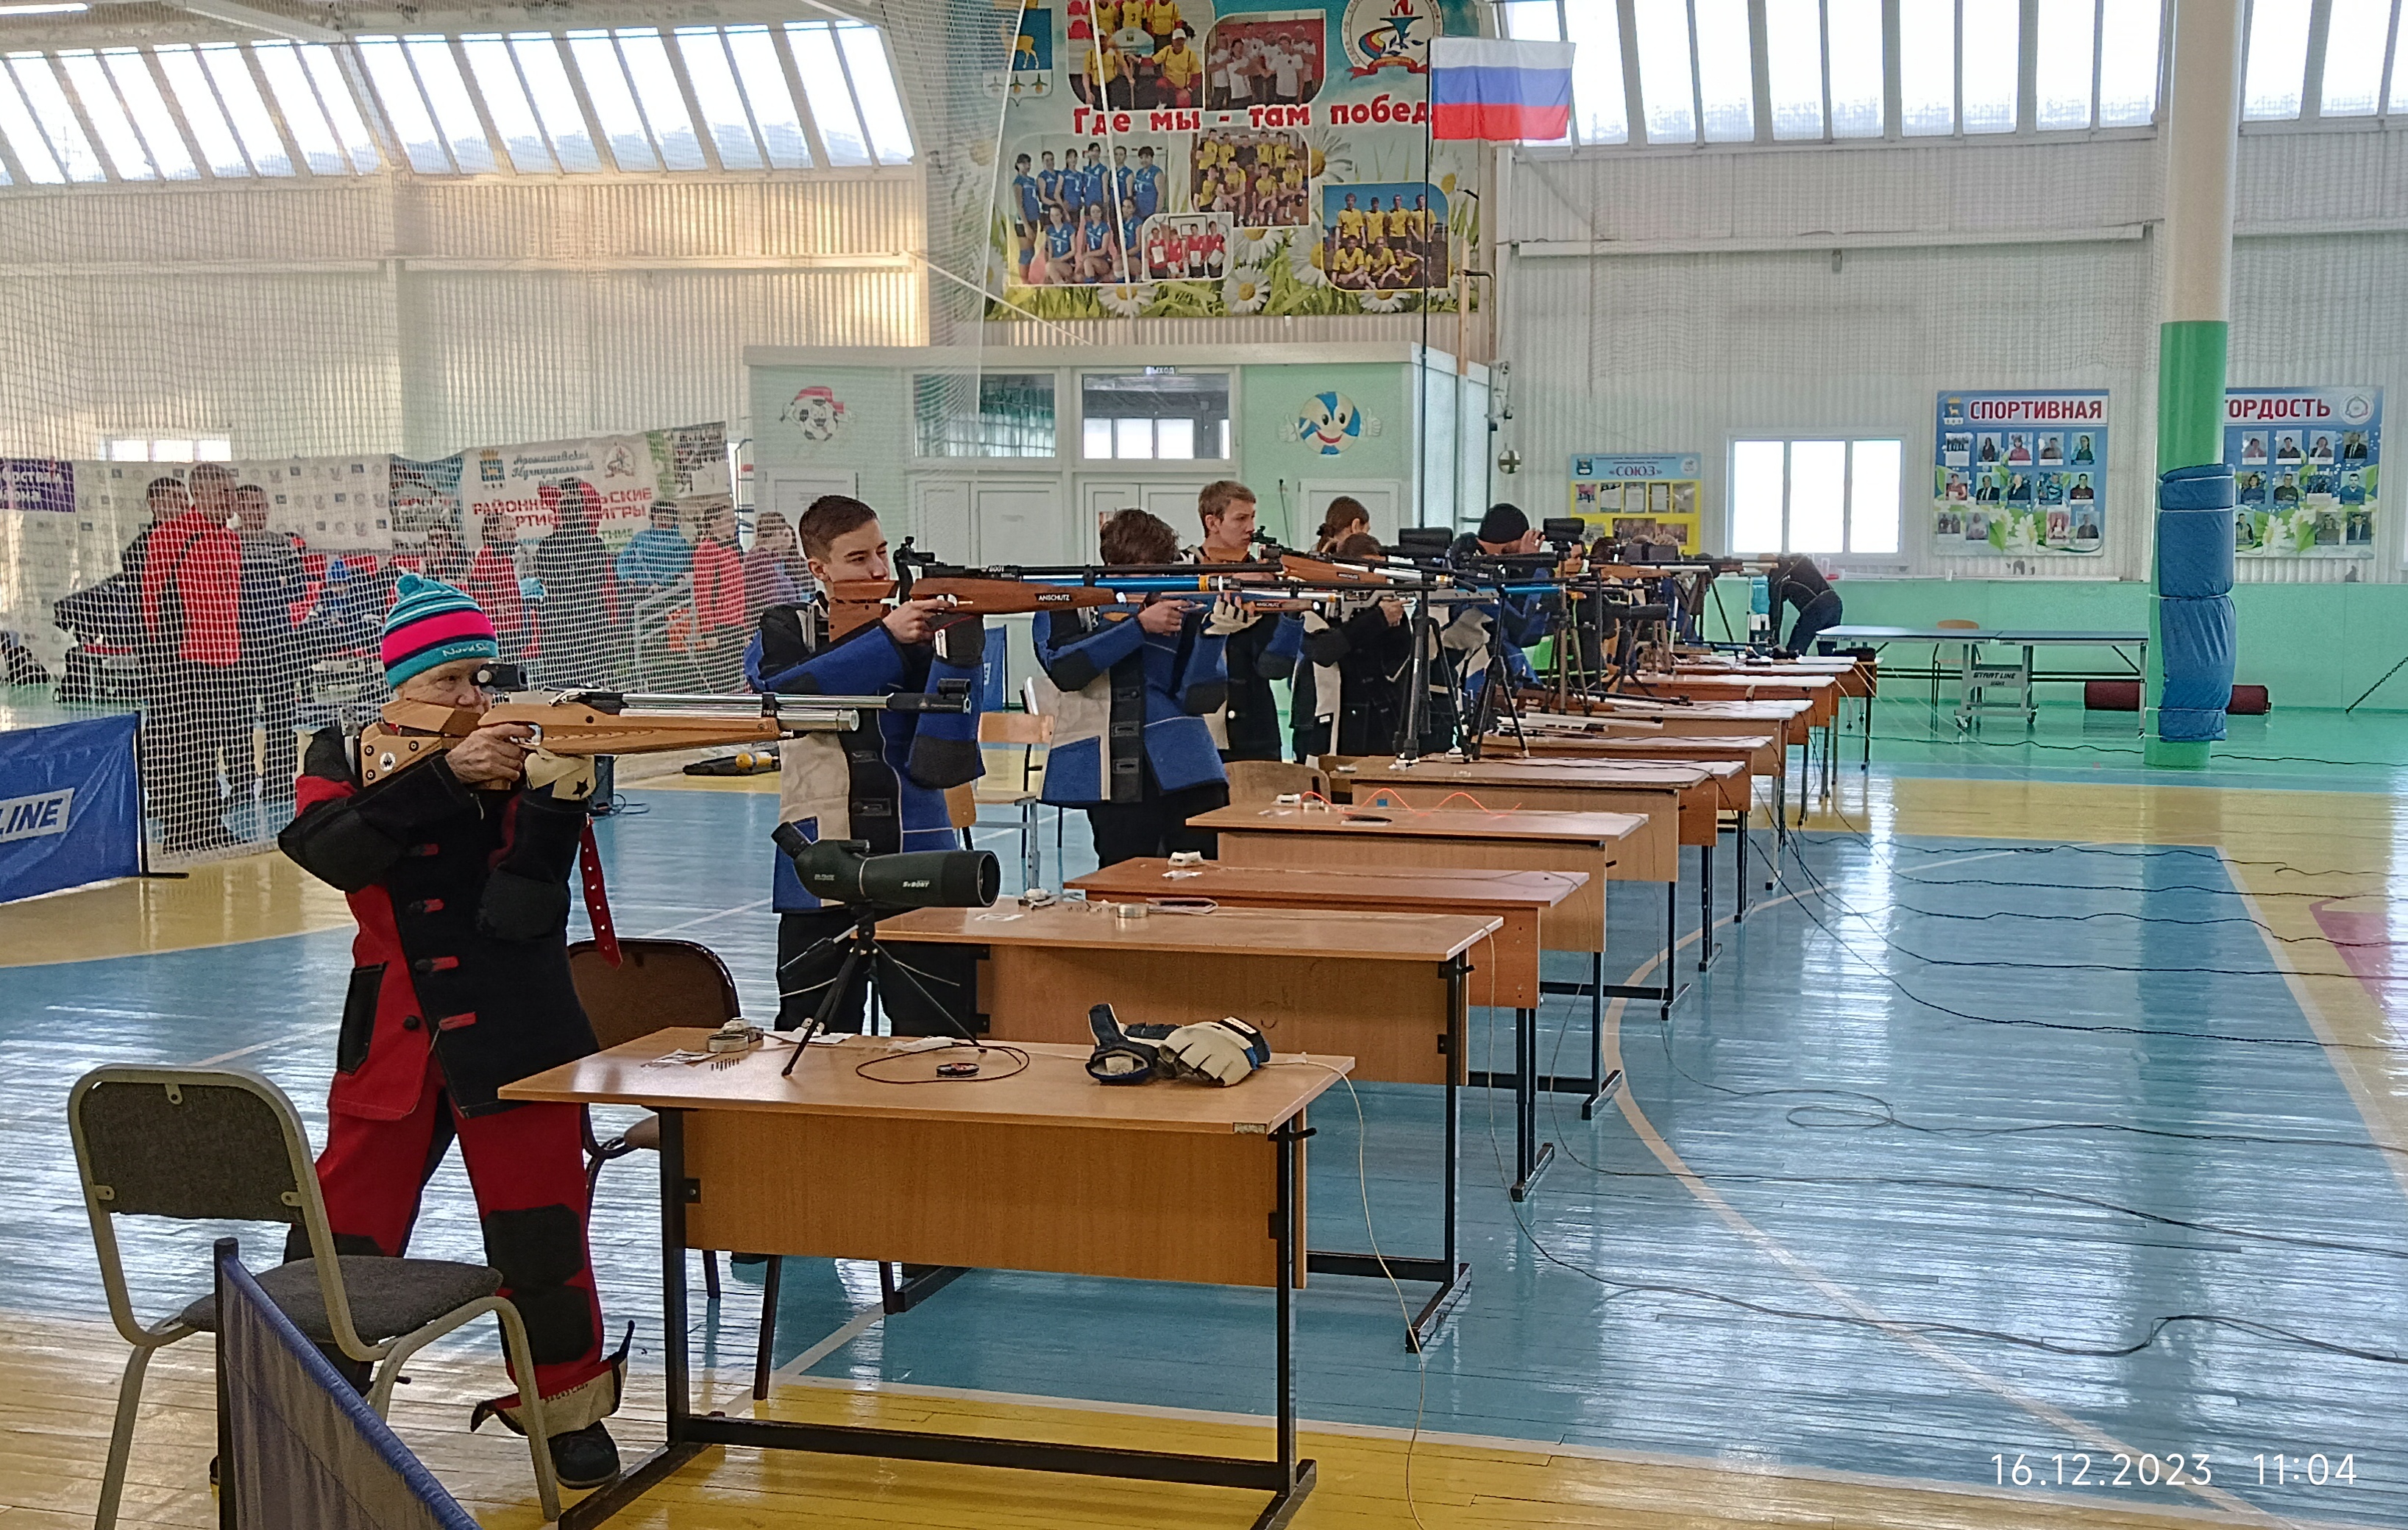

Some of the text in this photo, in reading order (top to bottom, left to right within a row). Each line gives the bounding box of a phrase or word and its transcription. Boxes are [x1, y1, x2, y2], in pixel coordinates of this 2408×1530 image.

[1073, 107, 1131, 135] Где
[1151, 111, 1200, 131] мы
[1249, 106, 1310, 127] там
[1330, 94, 1432, 124] побед
[1970, 400, 2102, 419] СПОРТИВНАЯ
[2225, 399, 2331, 419] ОРДОСТЬ
[0, 797, 64, 835] INE
